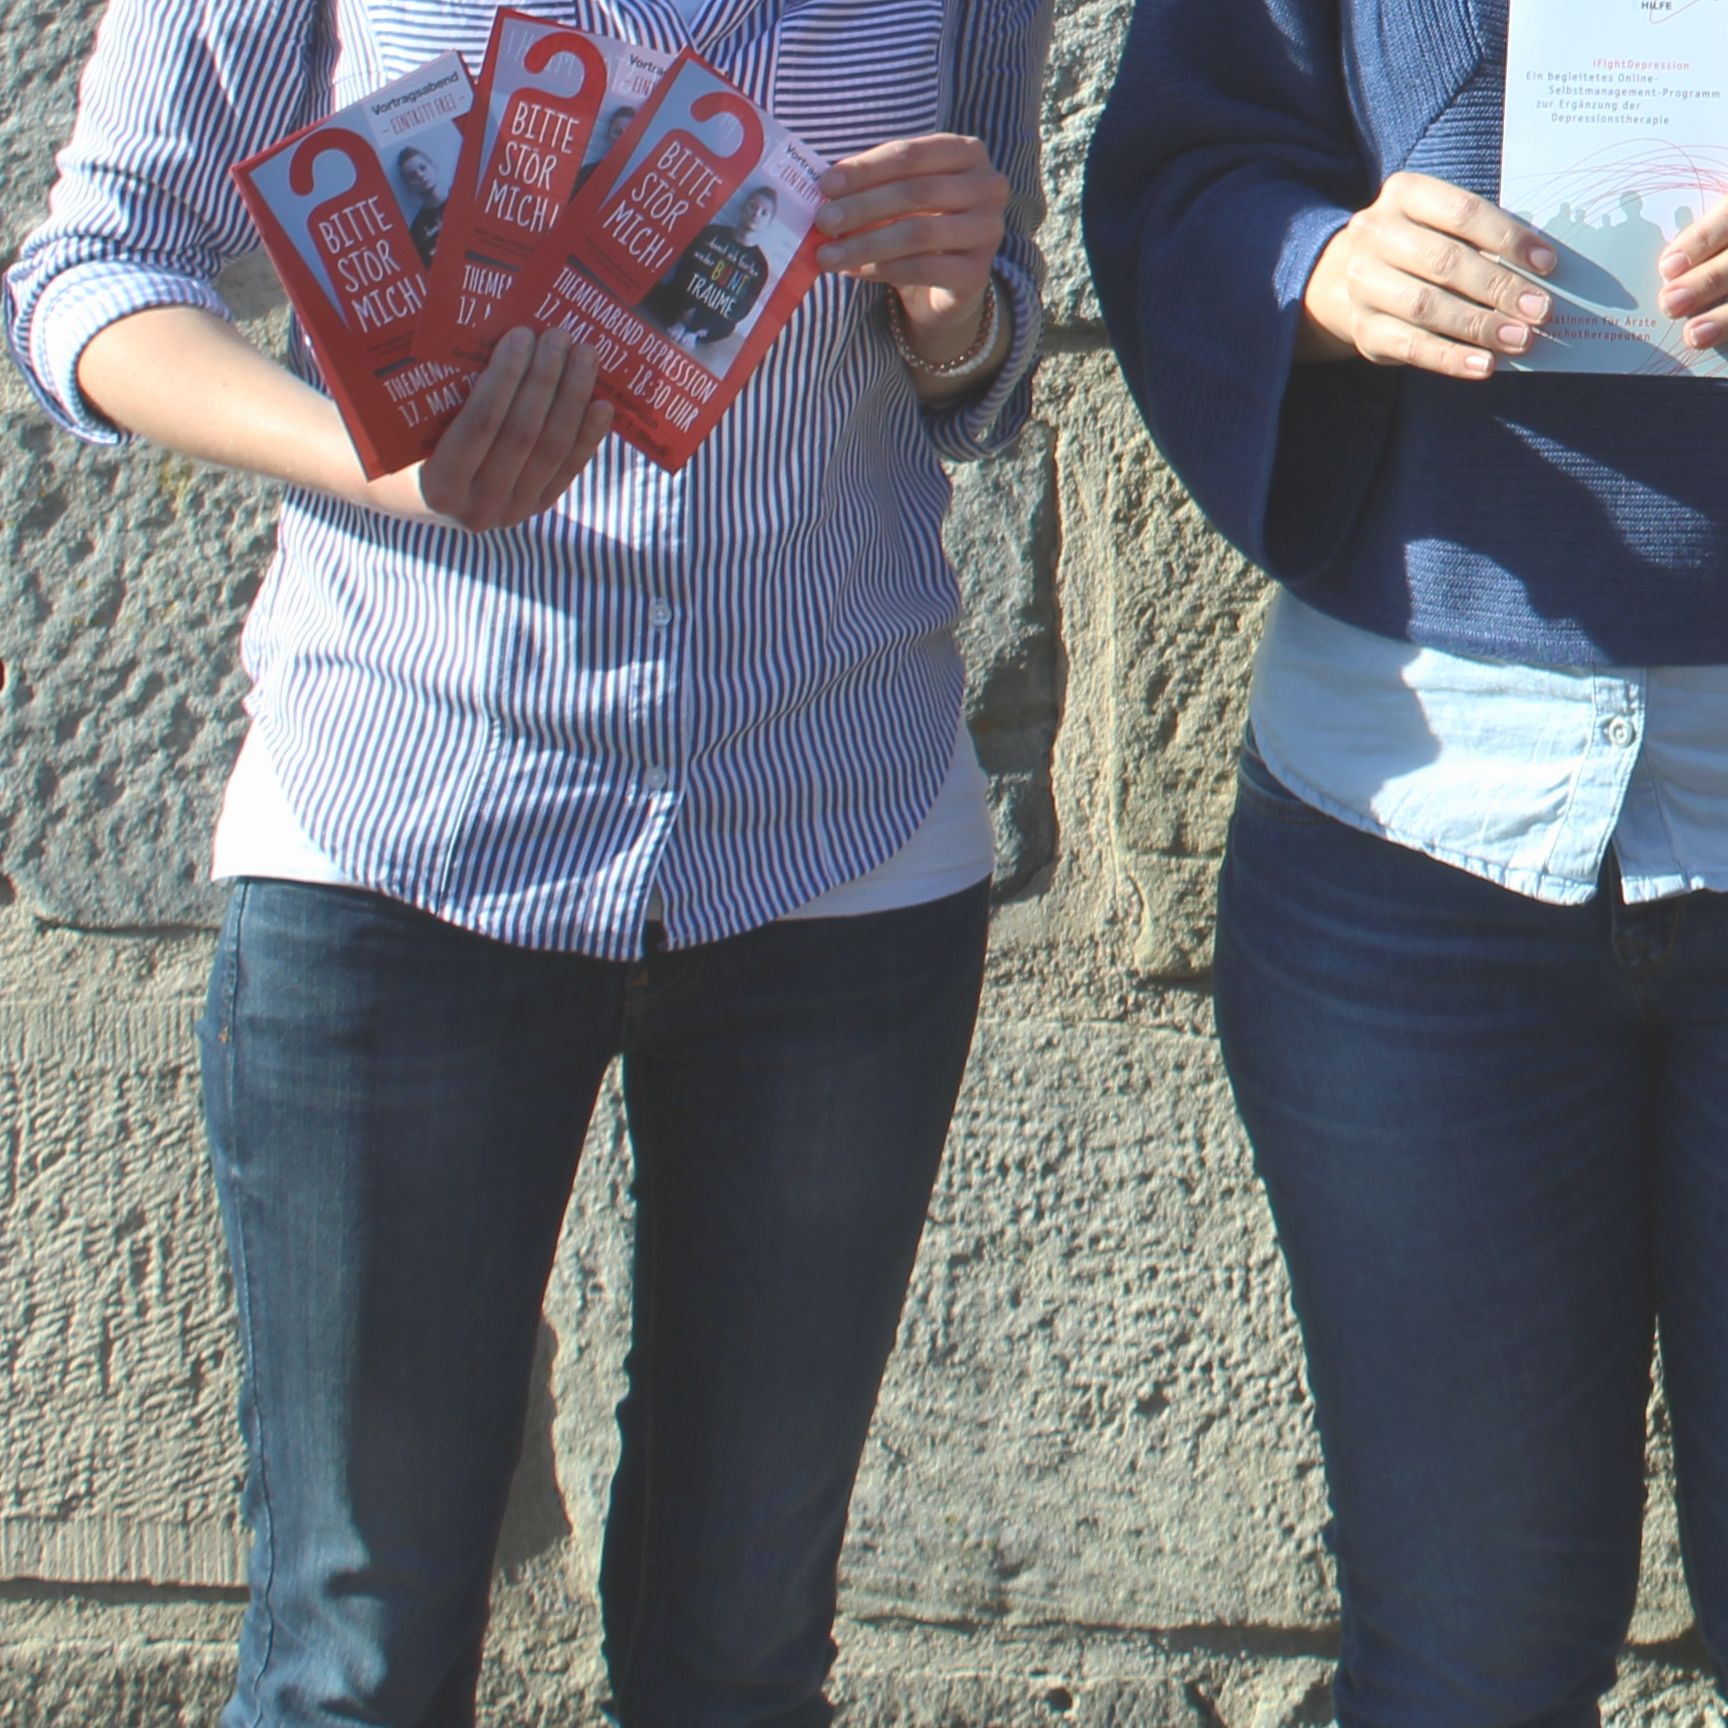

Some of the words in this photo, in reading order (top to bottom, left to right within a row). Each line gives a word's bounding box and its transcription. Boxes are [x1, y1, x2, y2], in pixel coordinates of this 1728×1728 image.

[1641, 1, 1672, 10] HILFE
[371, 71, 460, 116] Vortragsabend
[1526, 71, 1543, 81] Ein
[1547, 71, 1614, 83] begleitetes
[1548, 85, 1721, 99] Selbstmanagement-Programm
[511, 101, 580, 154] BITTE
[1622, 101, 1641, 111] der
[498, 141, 557, 191] STÖR
[657, 140, 723, 208] BITTE
[319, 196, 393, 255] BITTE
[631, 172, 689, 233] STÖR
[602, 200, 673, 272] MICH!
[337, 239, 400, 293] STÖR
[457, 295, 477, 328] 17.
[553, 267, 645, 347] THEMENABEND
[638, 332, 719, 405] DEPRESSION
[398, 400, 428, 428] 17.
[425, 382, 463, 416] MAI
[626, 364, 673, 411] 18:30
[664, 394, 700, 434] UHR
